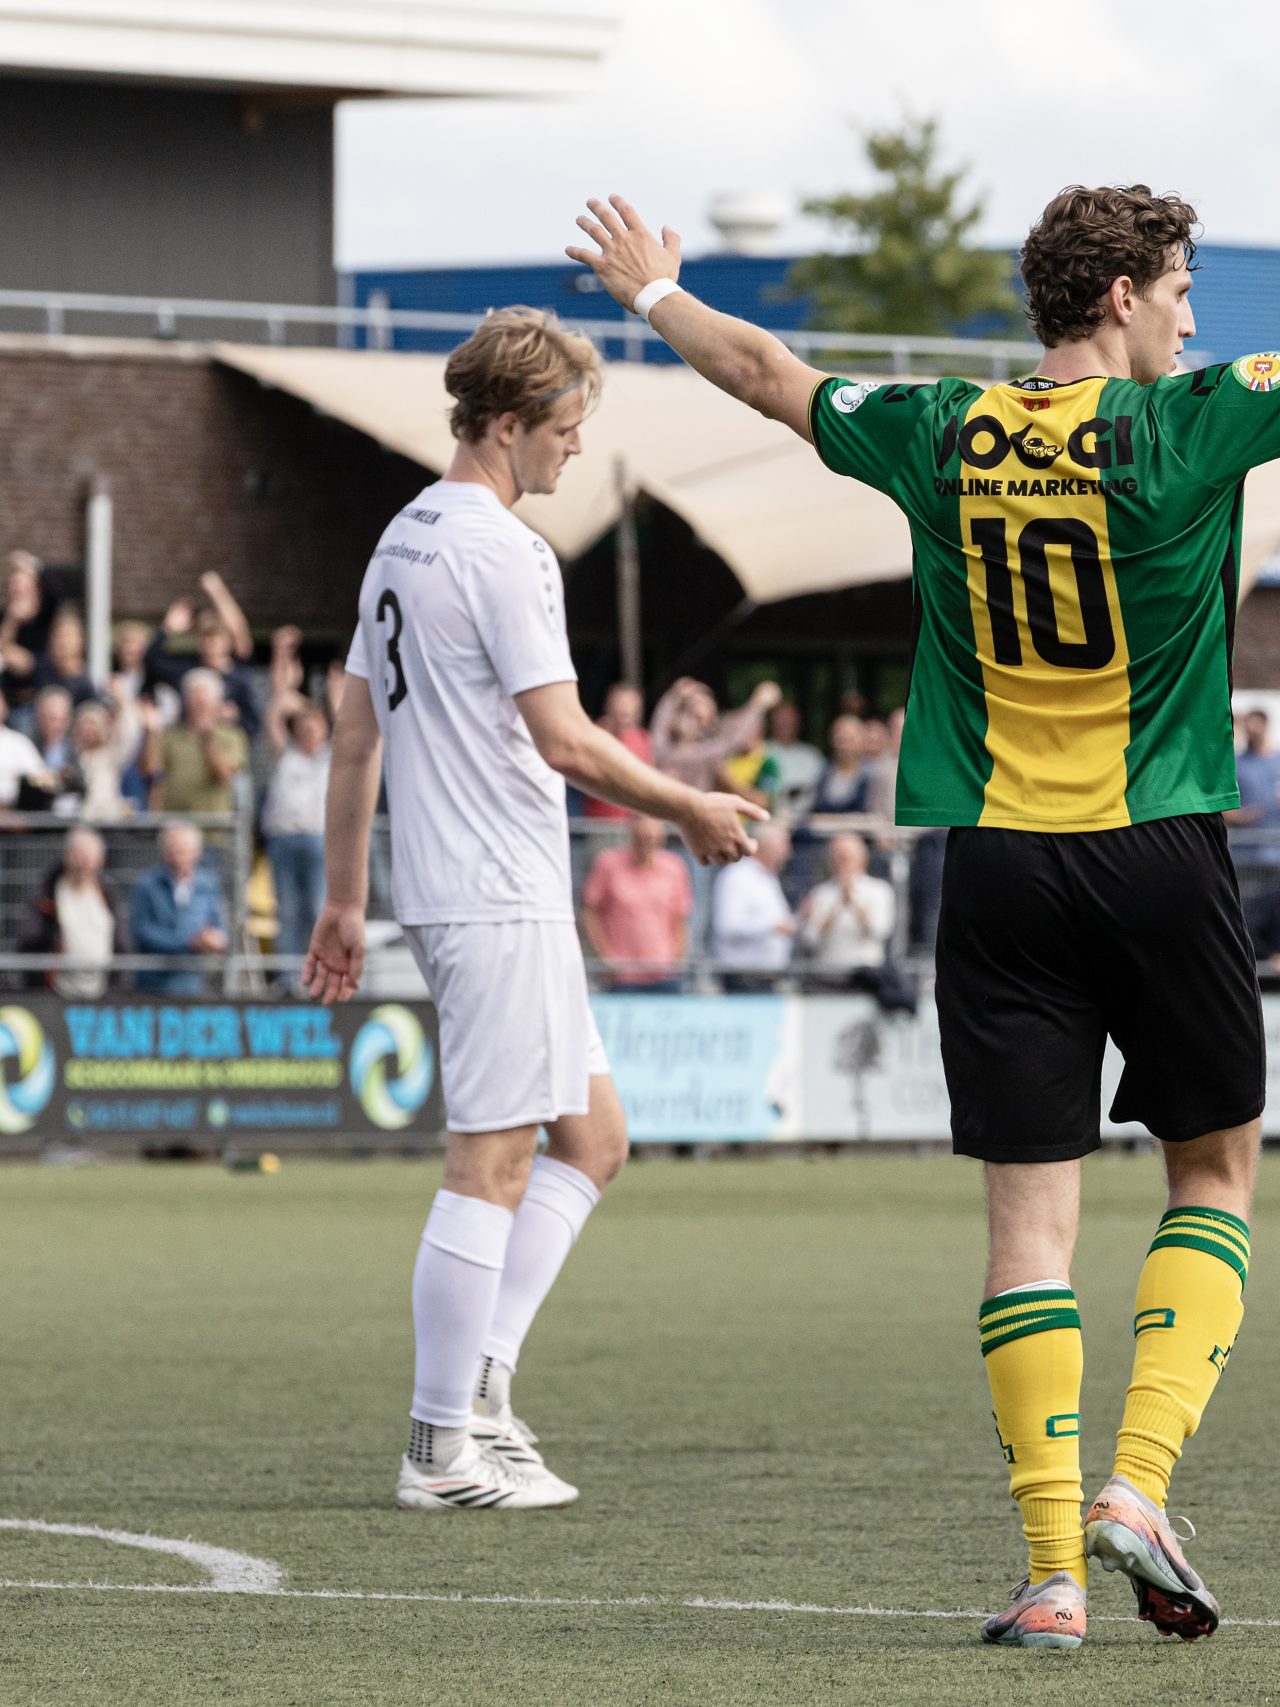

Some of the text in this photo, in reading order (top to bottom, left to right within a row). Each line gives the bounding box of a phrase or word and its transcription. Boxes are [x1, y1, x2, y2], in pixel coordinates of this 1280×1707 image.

[1006, 476, 1139, 497] MARKETING
[970, 516, 1116, 670] 10
[375, 588, 409, 712] 3
[64, 1006, 154, 1058] VAN
[157, 1006, 243, 1058] DER
